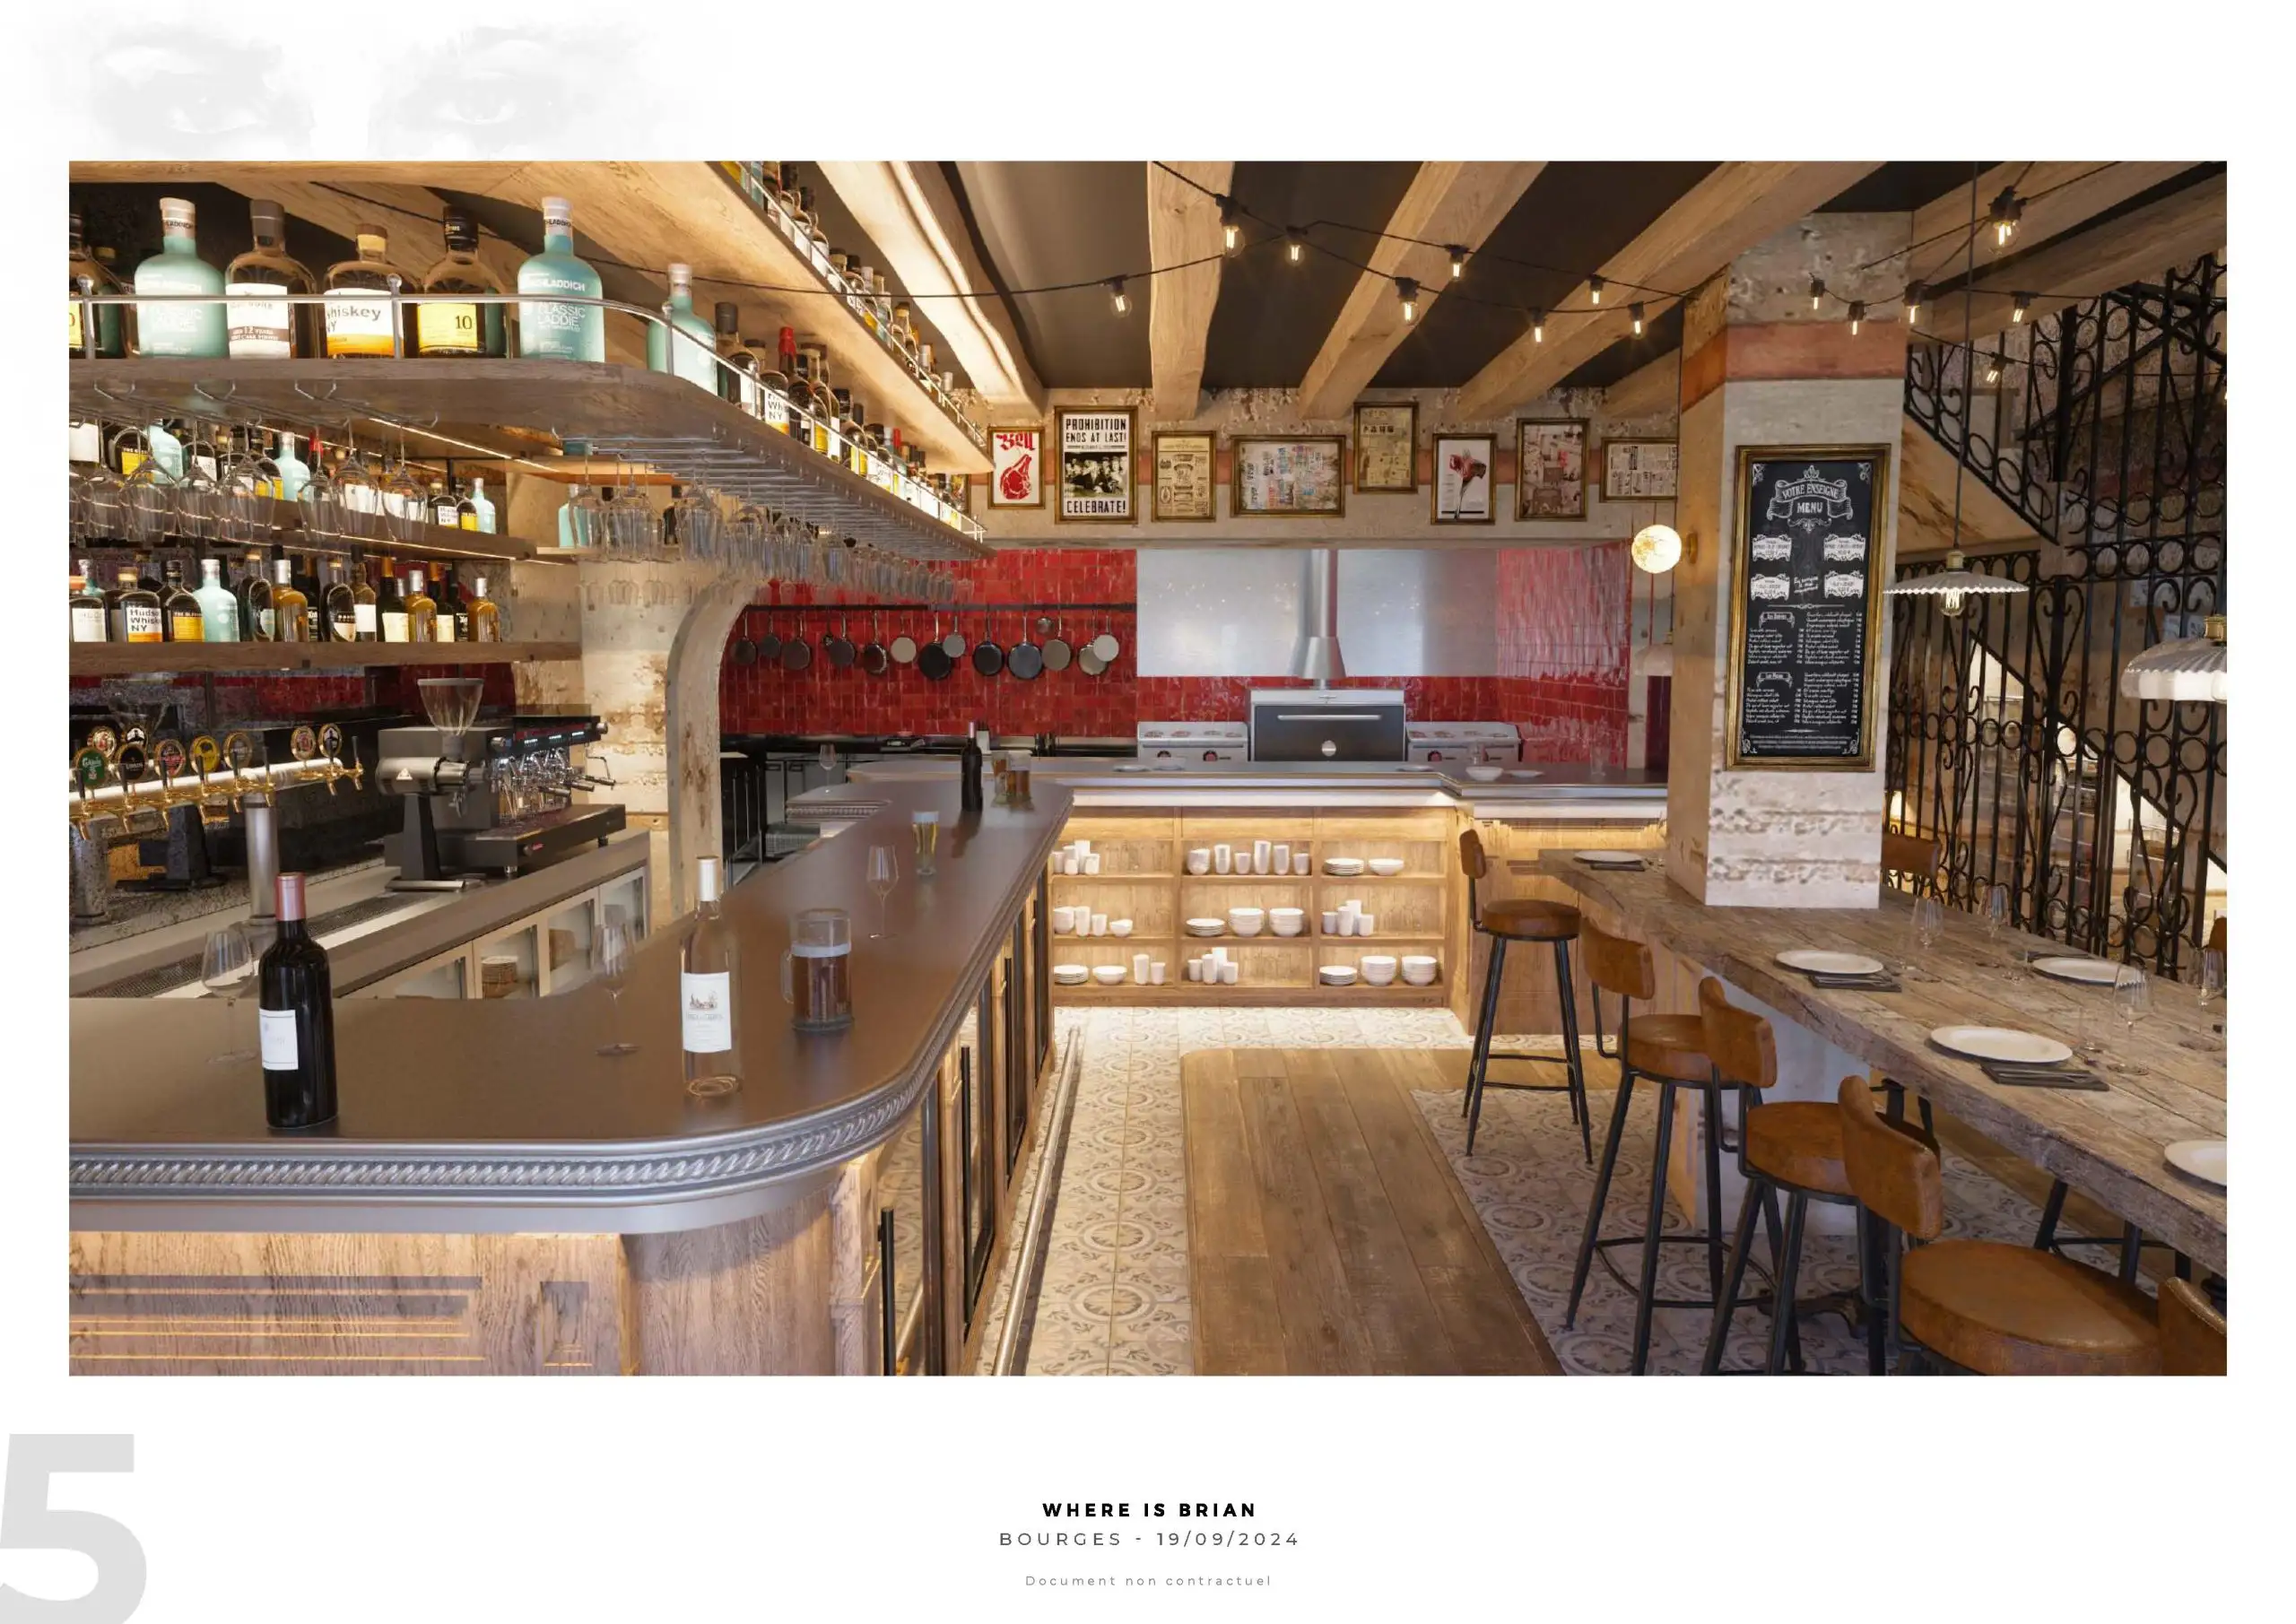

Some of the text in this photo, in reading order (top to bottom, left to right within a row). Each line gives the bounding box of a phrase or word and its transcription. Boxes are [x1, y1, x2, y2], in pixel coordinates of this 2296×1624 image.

[455, 315, 473, 330] 10
[1065, 418, 1126, 430] PROHIBITION
[1065, 432, 1126, 443] ENDS AT LAST!
[1782, 484, 1805, 499] VOTRE
[1066, 500, 1126, 513] CELEBRATE!
[1796, 502, 1823, 514] MENU
[130, 609, 160, 617] Hudso
